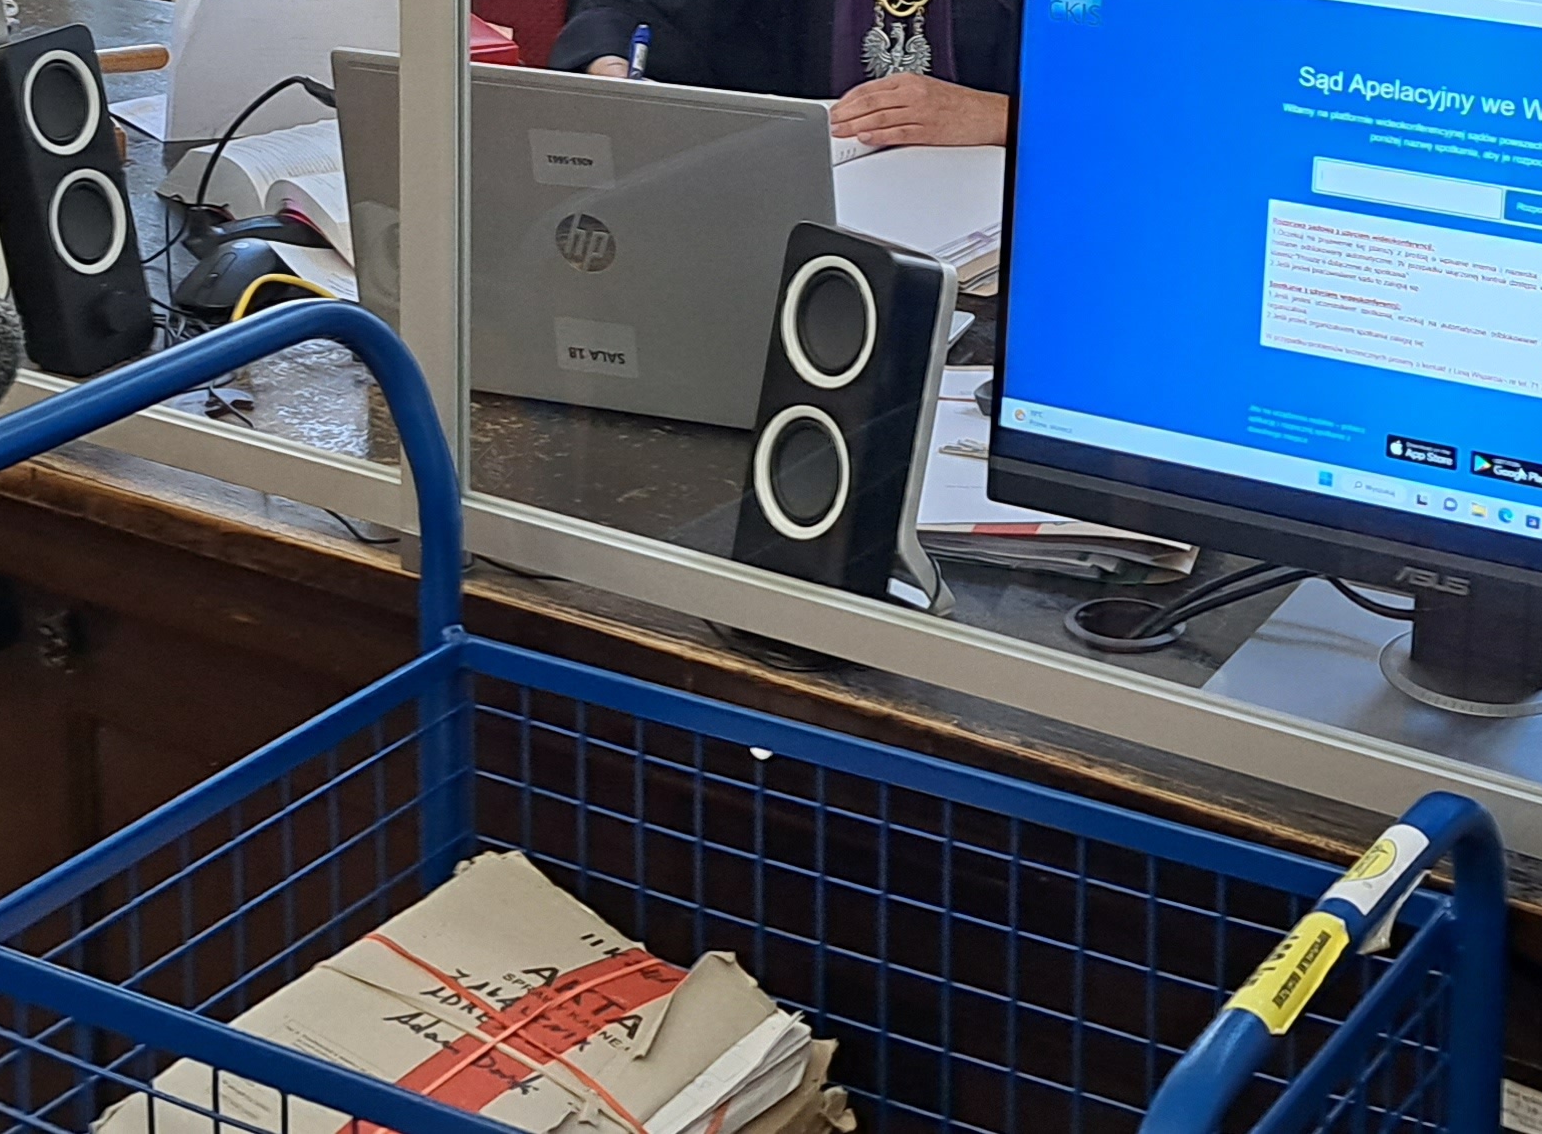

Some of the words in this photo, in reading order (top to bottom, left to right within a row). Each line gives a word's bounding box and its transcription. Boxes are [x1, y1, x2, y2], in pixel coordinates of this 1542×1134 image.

[1298, 65, 1344, 95] Sąd
[1348, 71, 1475, 116] Apelacyjny
[1481, 96, 1516, 116] we
[560, 213, 613, 272] hp
[591, 350, 627, 365] SALA
[1493, 465, 1527, 481] Goog
[1396, 566, 1471, 596] ASUS
